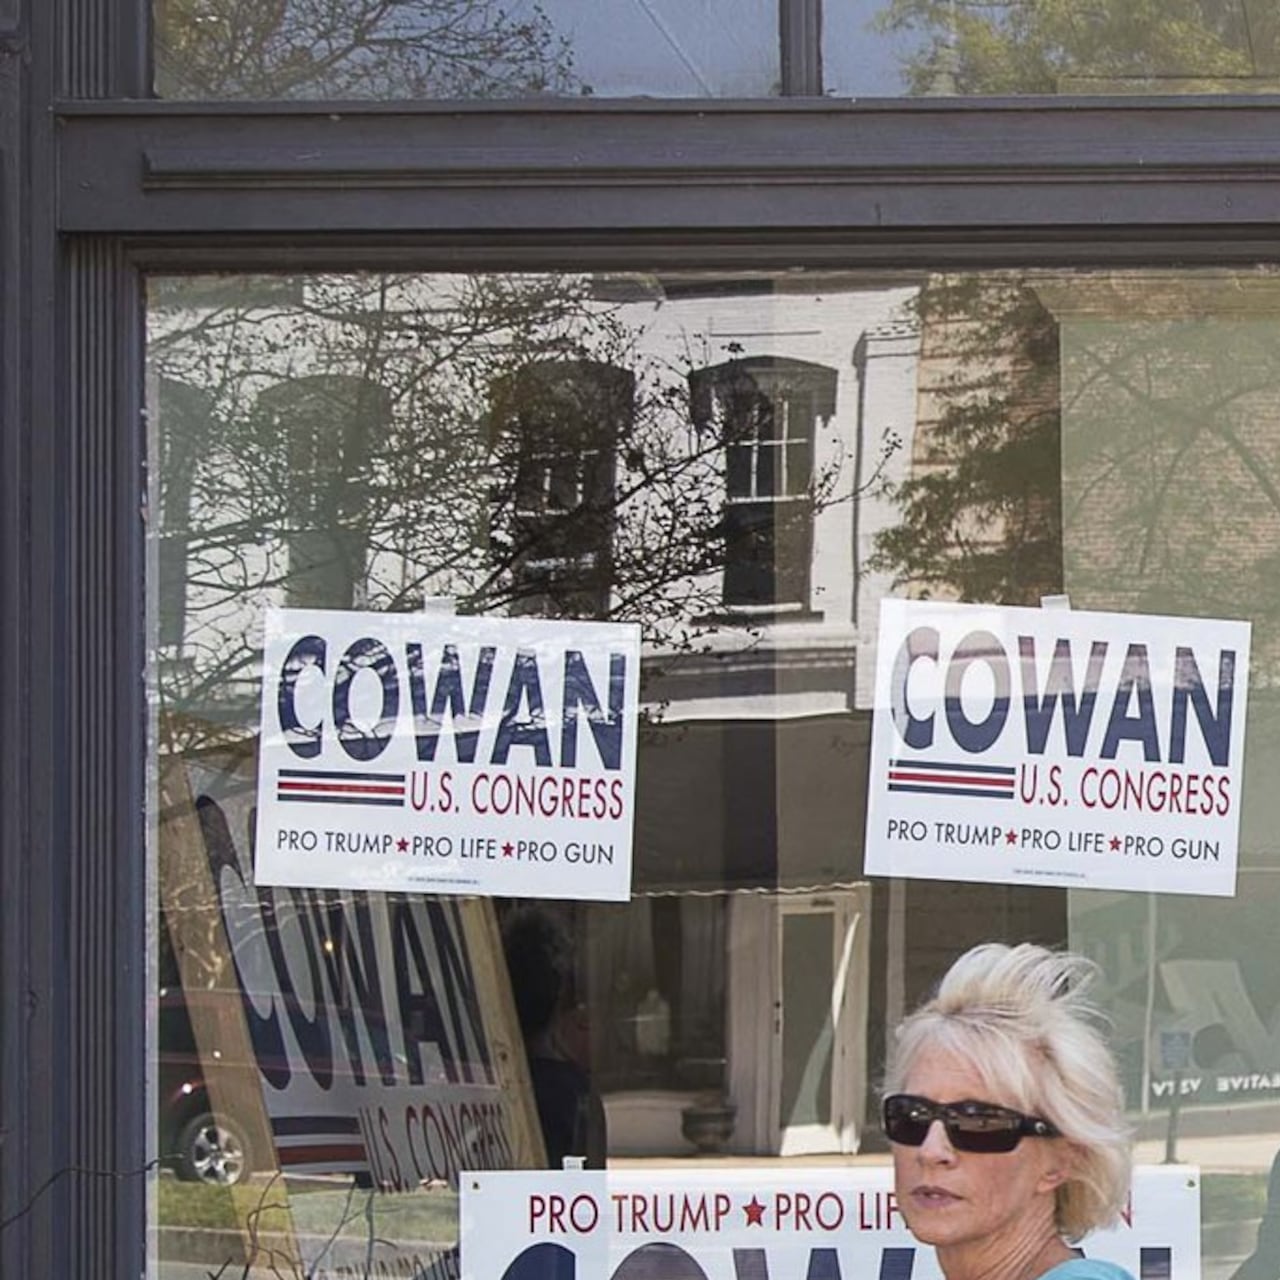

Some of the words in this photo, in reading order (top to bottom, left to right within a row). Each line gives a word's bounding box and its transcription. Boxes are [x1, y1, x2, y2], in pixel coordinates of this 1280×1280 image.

[277, 635, 626, 770] COWAN
[890, 626, 1236, 767] COWAN
[410, 771, 459, 814] U.S.
[472, 773, 624, 820] CONGRESS
[1020, 763, 1068, 807] U.S.
[1080, 766, 1231, 817] CONGRESS
[278, 830, 318, 851] PRO
[325, 832, 393, 854] TRUMP
[412, 836, 453, 857] PRO
[461, 838, 497, 860] LIFE
[517, 842, 557, 862] PRO
[564, 843, 614, 865] GUN
[888, 819, 928, 842] PRO
[935, 822, 1002, 846] TRUMP
[1021, 828, 1061, 850] PRO
[1068, 831, 1104, 853] LIFE
[1125, 835, 1164, 858] PRO
[1171, 838, 1220, 861] GUN
[529, 1195, 598, 1233] PRO
[612, 1195, 731, 1232] TRUMP
[776, 1194, 843, 1231] PRO
[859, 1193, 910, 1230] LIF
